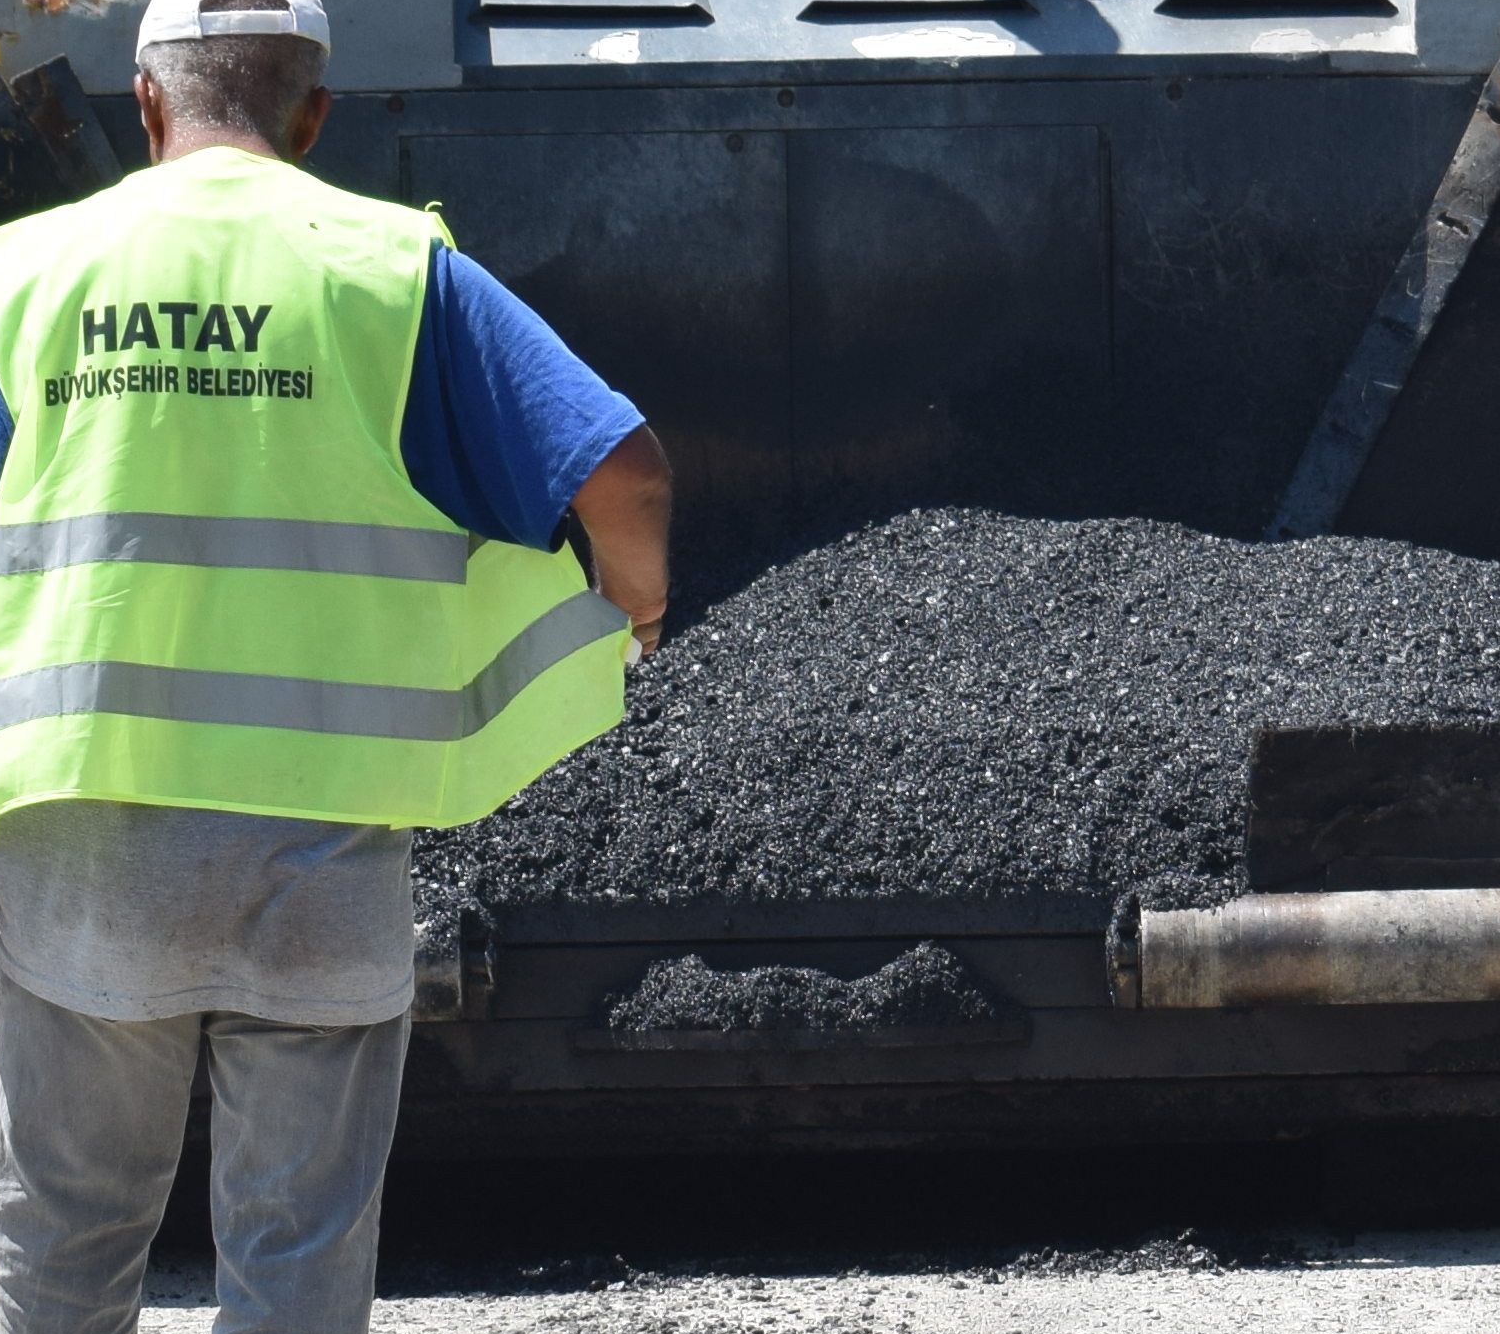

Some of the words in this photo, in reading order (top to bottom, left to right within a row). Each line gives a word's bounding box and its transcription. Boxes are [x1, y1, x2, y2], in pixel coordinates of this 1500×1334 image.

[82, 301, 273, 356] HATAY
[44, 358, 180, 407] BÜYÜKŞEHİR
[186, 361, 314, 400] BELEDİYESİ
